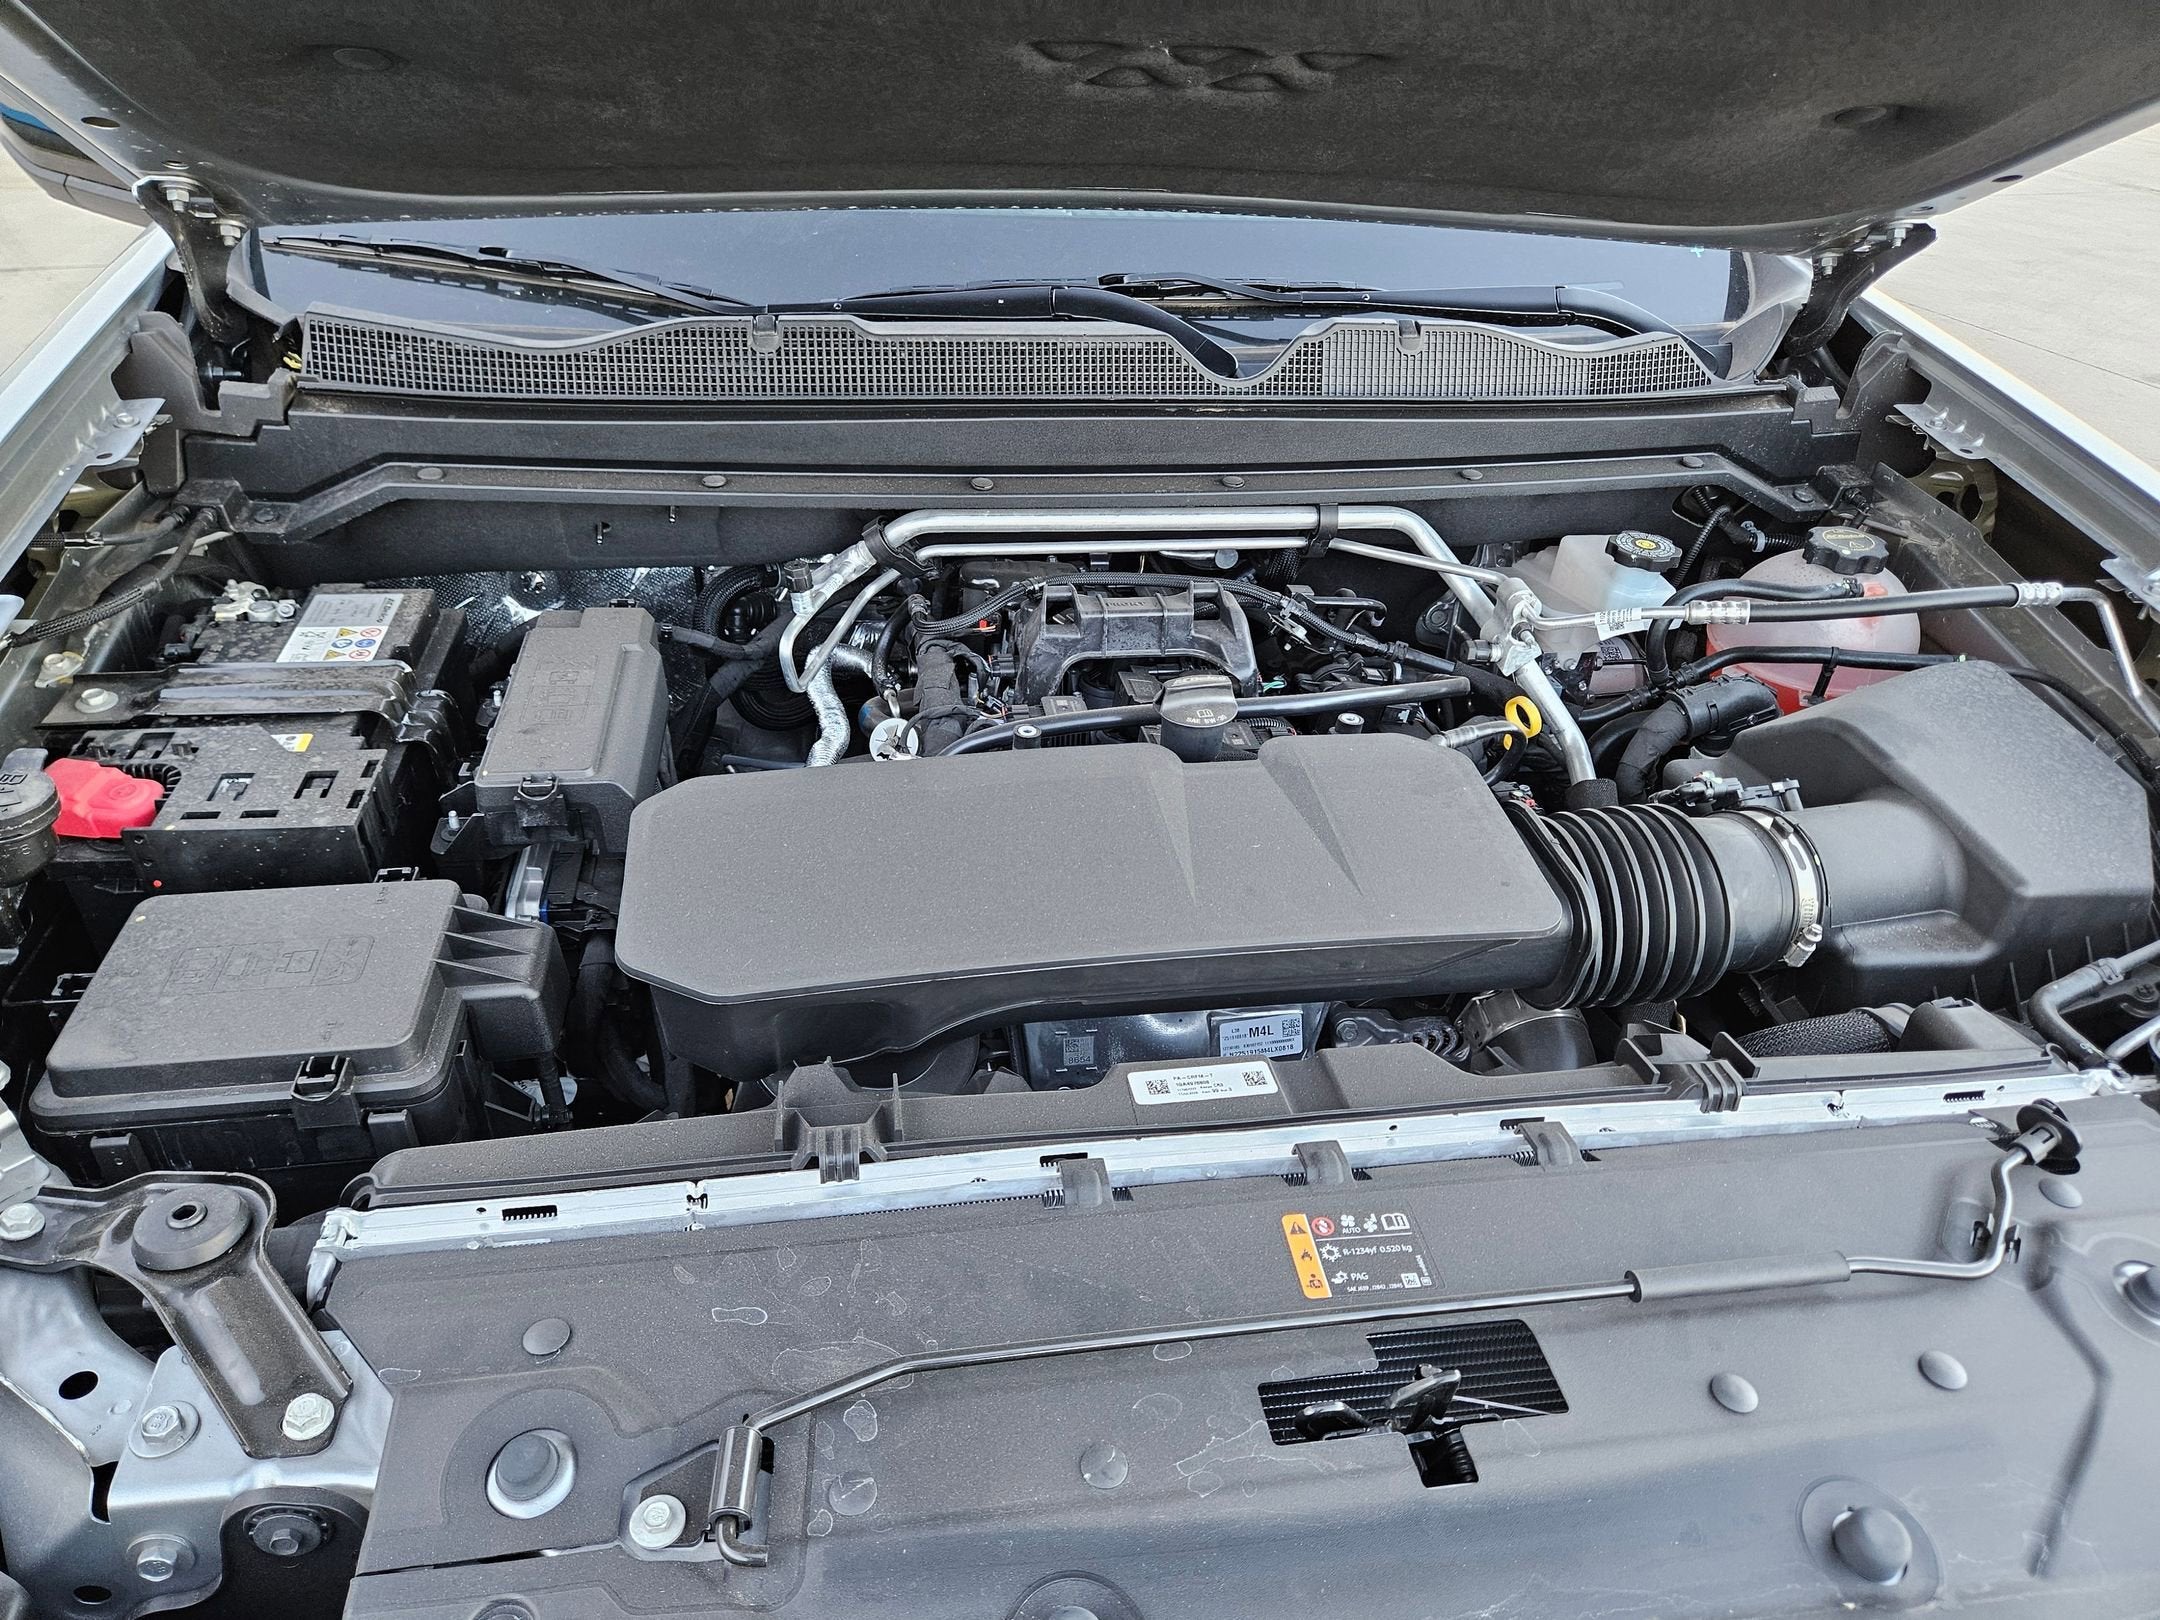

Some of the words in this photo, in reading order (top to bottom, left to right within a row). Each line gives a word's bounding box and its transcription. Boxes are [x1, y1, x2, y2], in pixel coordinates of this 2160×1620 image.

[1186, 716, 1201, 724] SAE
[1248, 1025, 1274, 1039] M4L
[1069, 1056, 1091, 1064] 8654
[1342, 1246, 1377, 1256] R-1234yf
[1379, 1245, 1400, 1253] 0.520
[1402, 1244, 1412, 1252] kg
[1350, 1272, 1369, 1280] PAG
